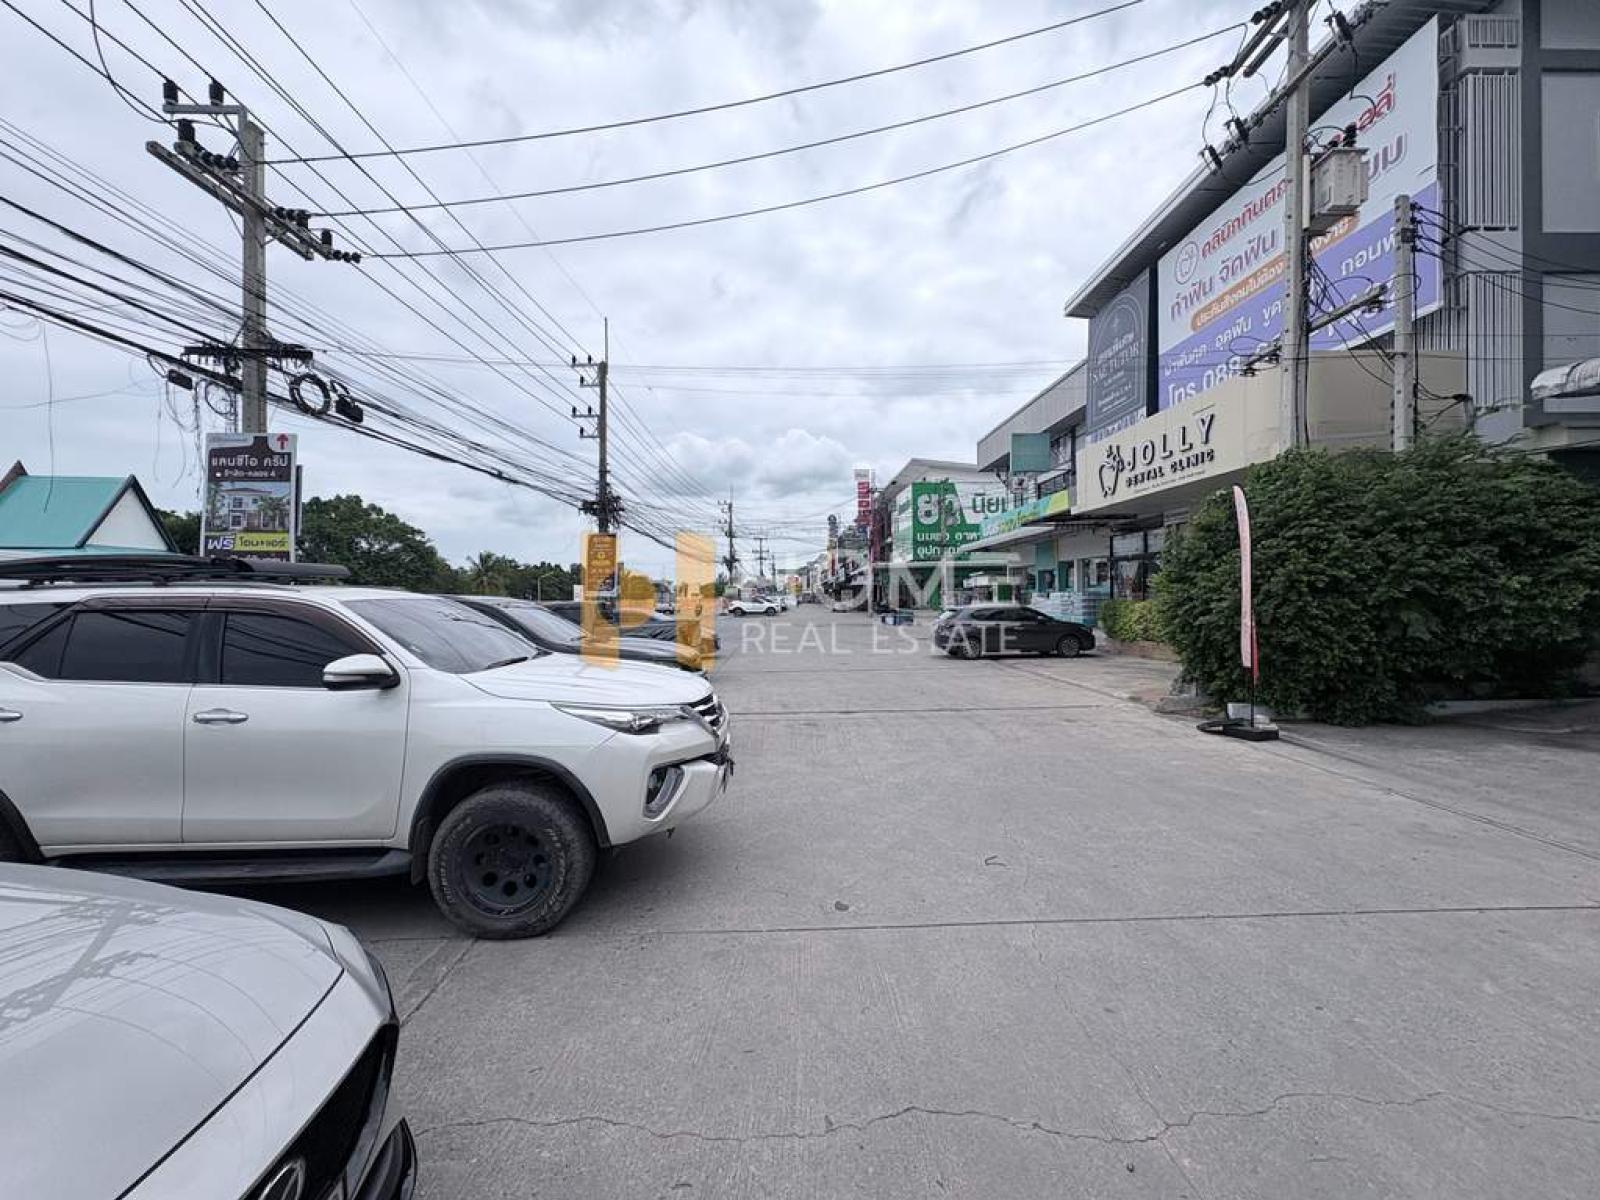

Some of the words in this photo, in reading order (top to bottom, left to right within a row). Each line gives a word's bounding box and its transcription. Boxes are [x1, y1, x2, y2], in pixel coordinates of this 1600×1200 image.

[1218, 230, 1277, 283] จัดฟัน
[1126, 465, 1165, 488] DENTAL
[1170, 448, 1214, 473] CLINIC
[1127, 413, 1215, 472] JOLLY
